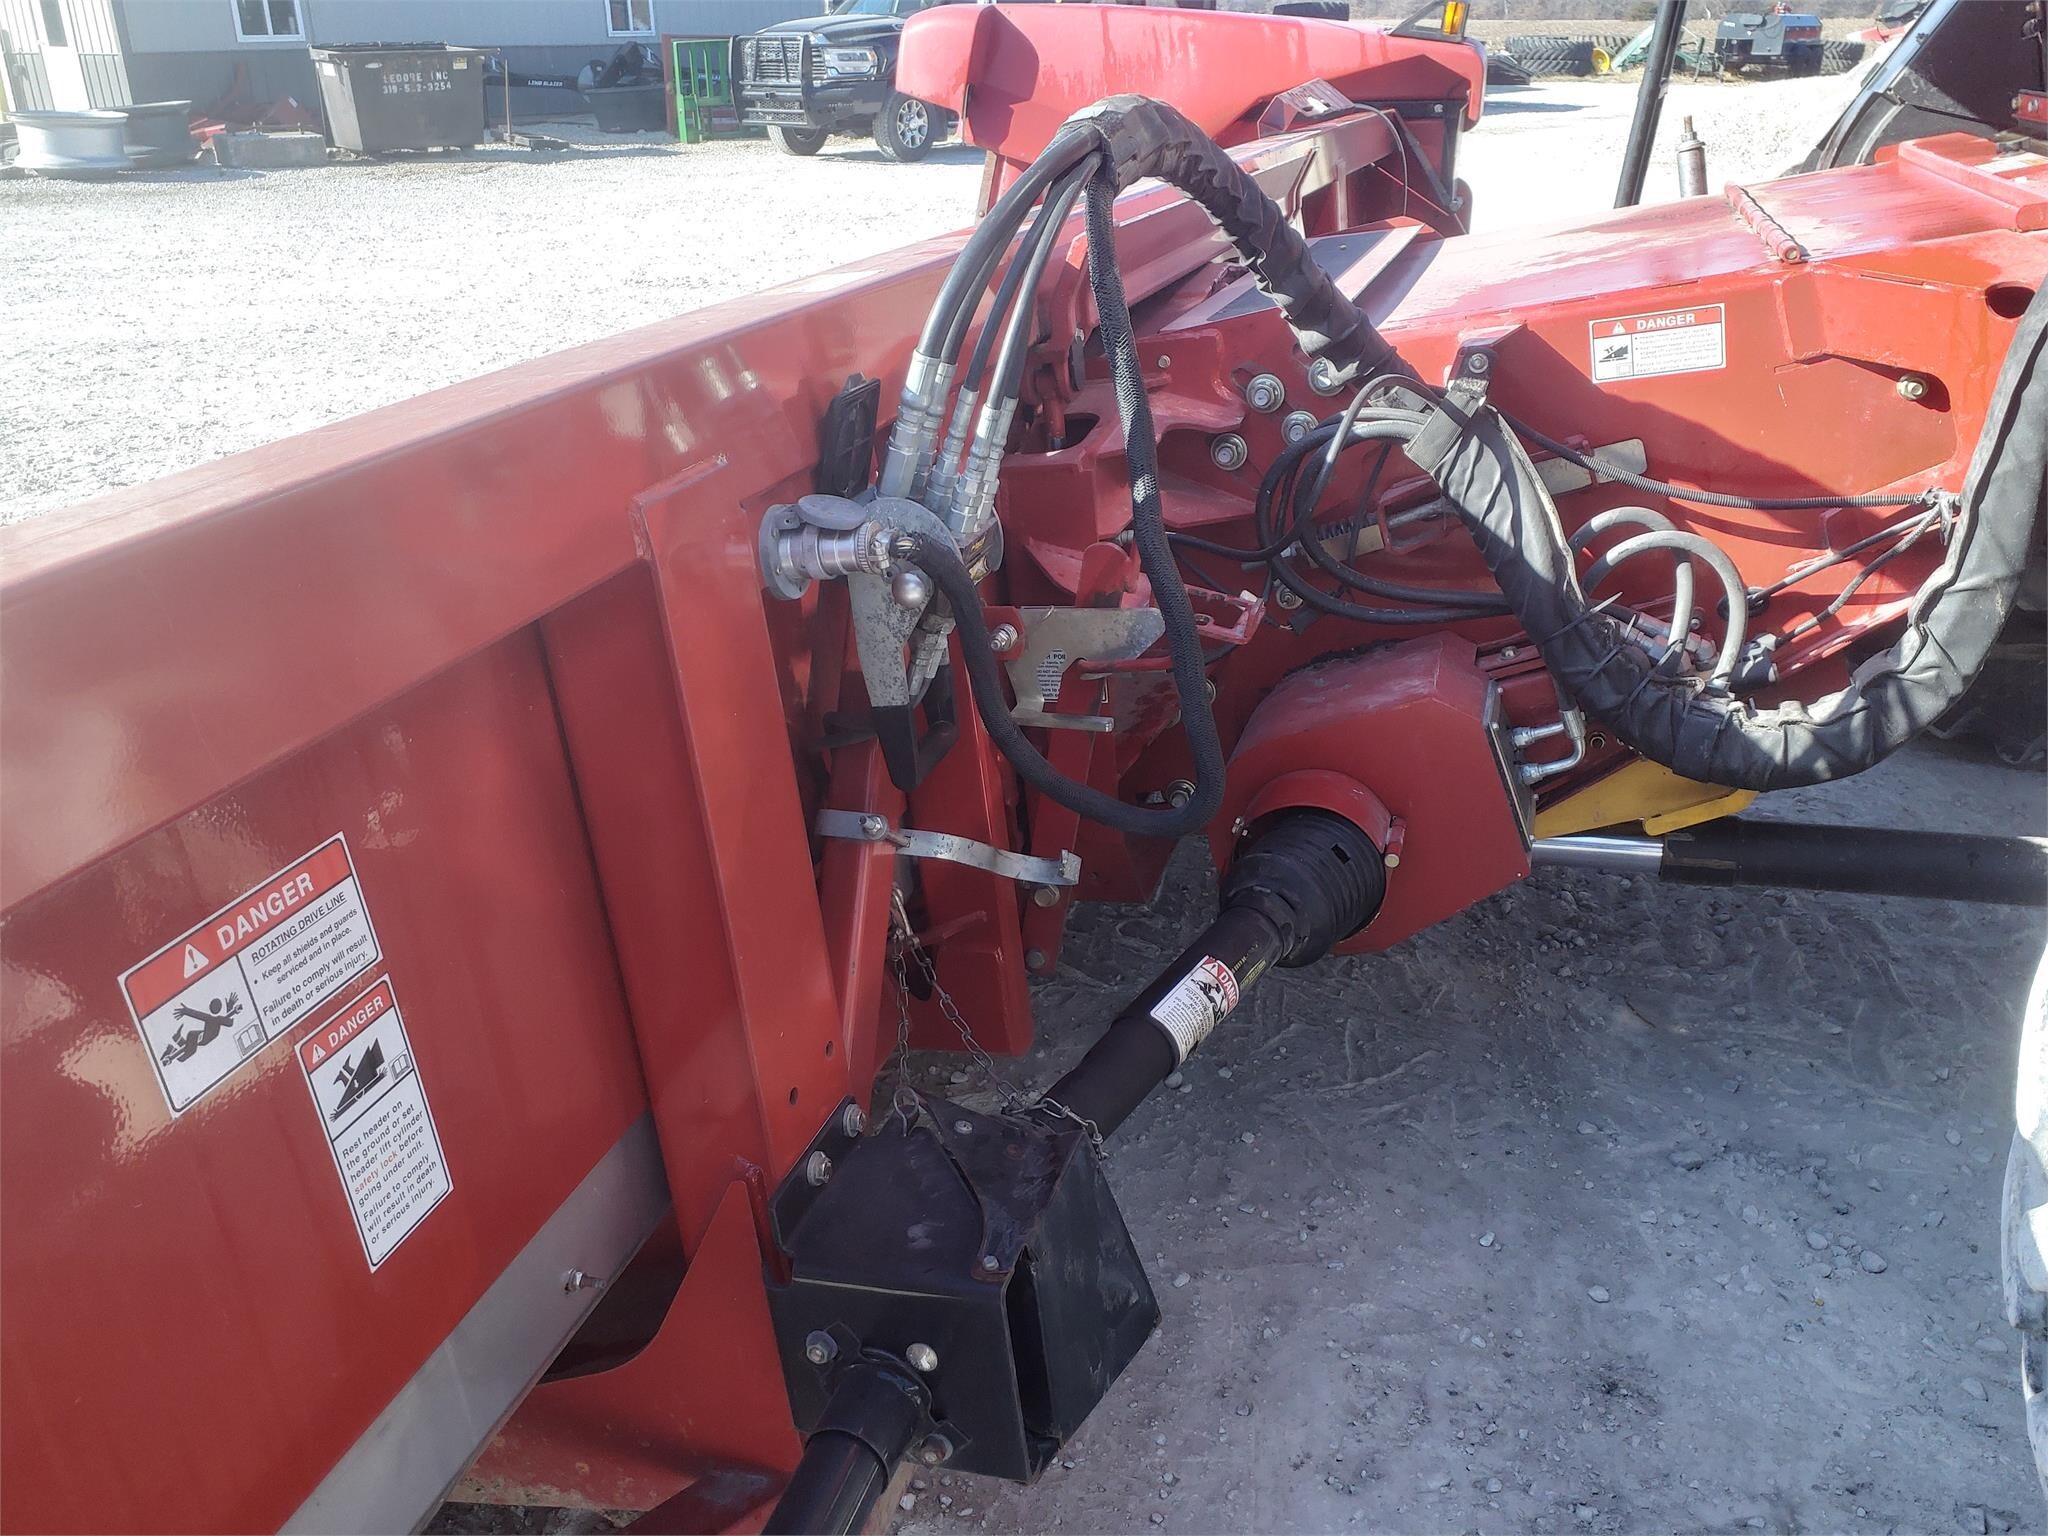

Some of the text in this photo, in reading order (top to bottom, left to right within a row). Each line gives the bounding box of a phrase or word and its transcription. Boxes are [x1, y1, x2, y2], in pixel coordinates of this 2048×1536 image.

[382, 81, 452, 94] 319-52-3254
[430, 71, 448, 81] INC
[1637, 313, 1696, 330] DANGER
[217, 872, 314, 950] DANGER
[251, 892, 347, 963] ROTATING DRIVE LINE
[262, 908, 358, 980] Keep all shields and guards
[262, 991, 292, 1016] Failure
[292, 983, 302, 995] to
[302, 963, 331, 987] comply
[331, 950, 346, 965] will
[346, 934, 368, 955] result
[271, 1014, 281, 1026] in
[281, 997, 305, 1020] death
[305, 989, 315, 1000] or
[315, 966, 344, 994] serious
[344, 953, 368, 972] injury.
[276, 928, 352, 985] serviced and in place.
[1219, 971, 1237, 1010] DANG
[328, 995, 384, 1048] DANGER
[342, 1100, 403, 1159] Rest header on
[346, 1103, 415, 1171] the ground or set
[350, 1110, 424, 1183] header lift cylinder
[354, 1125, 424, 1195] safety lock before
[358, 1140, 425, 1208] going under unit.
[363, 1153, 429, 1222] Failure to comply
[367, 1160, 437, 1233] will result in death
[371, 1232, 380, 1245] or
[381, 1202, 411, 1234] serious
[411, 1178, 435, 1204] injury.
